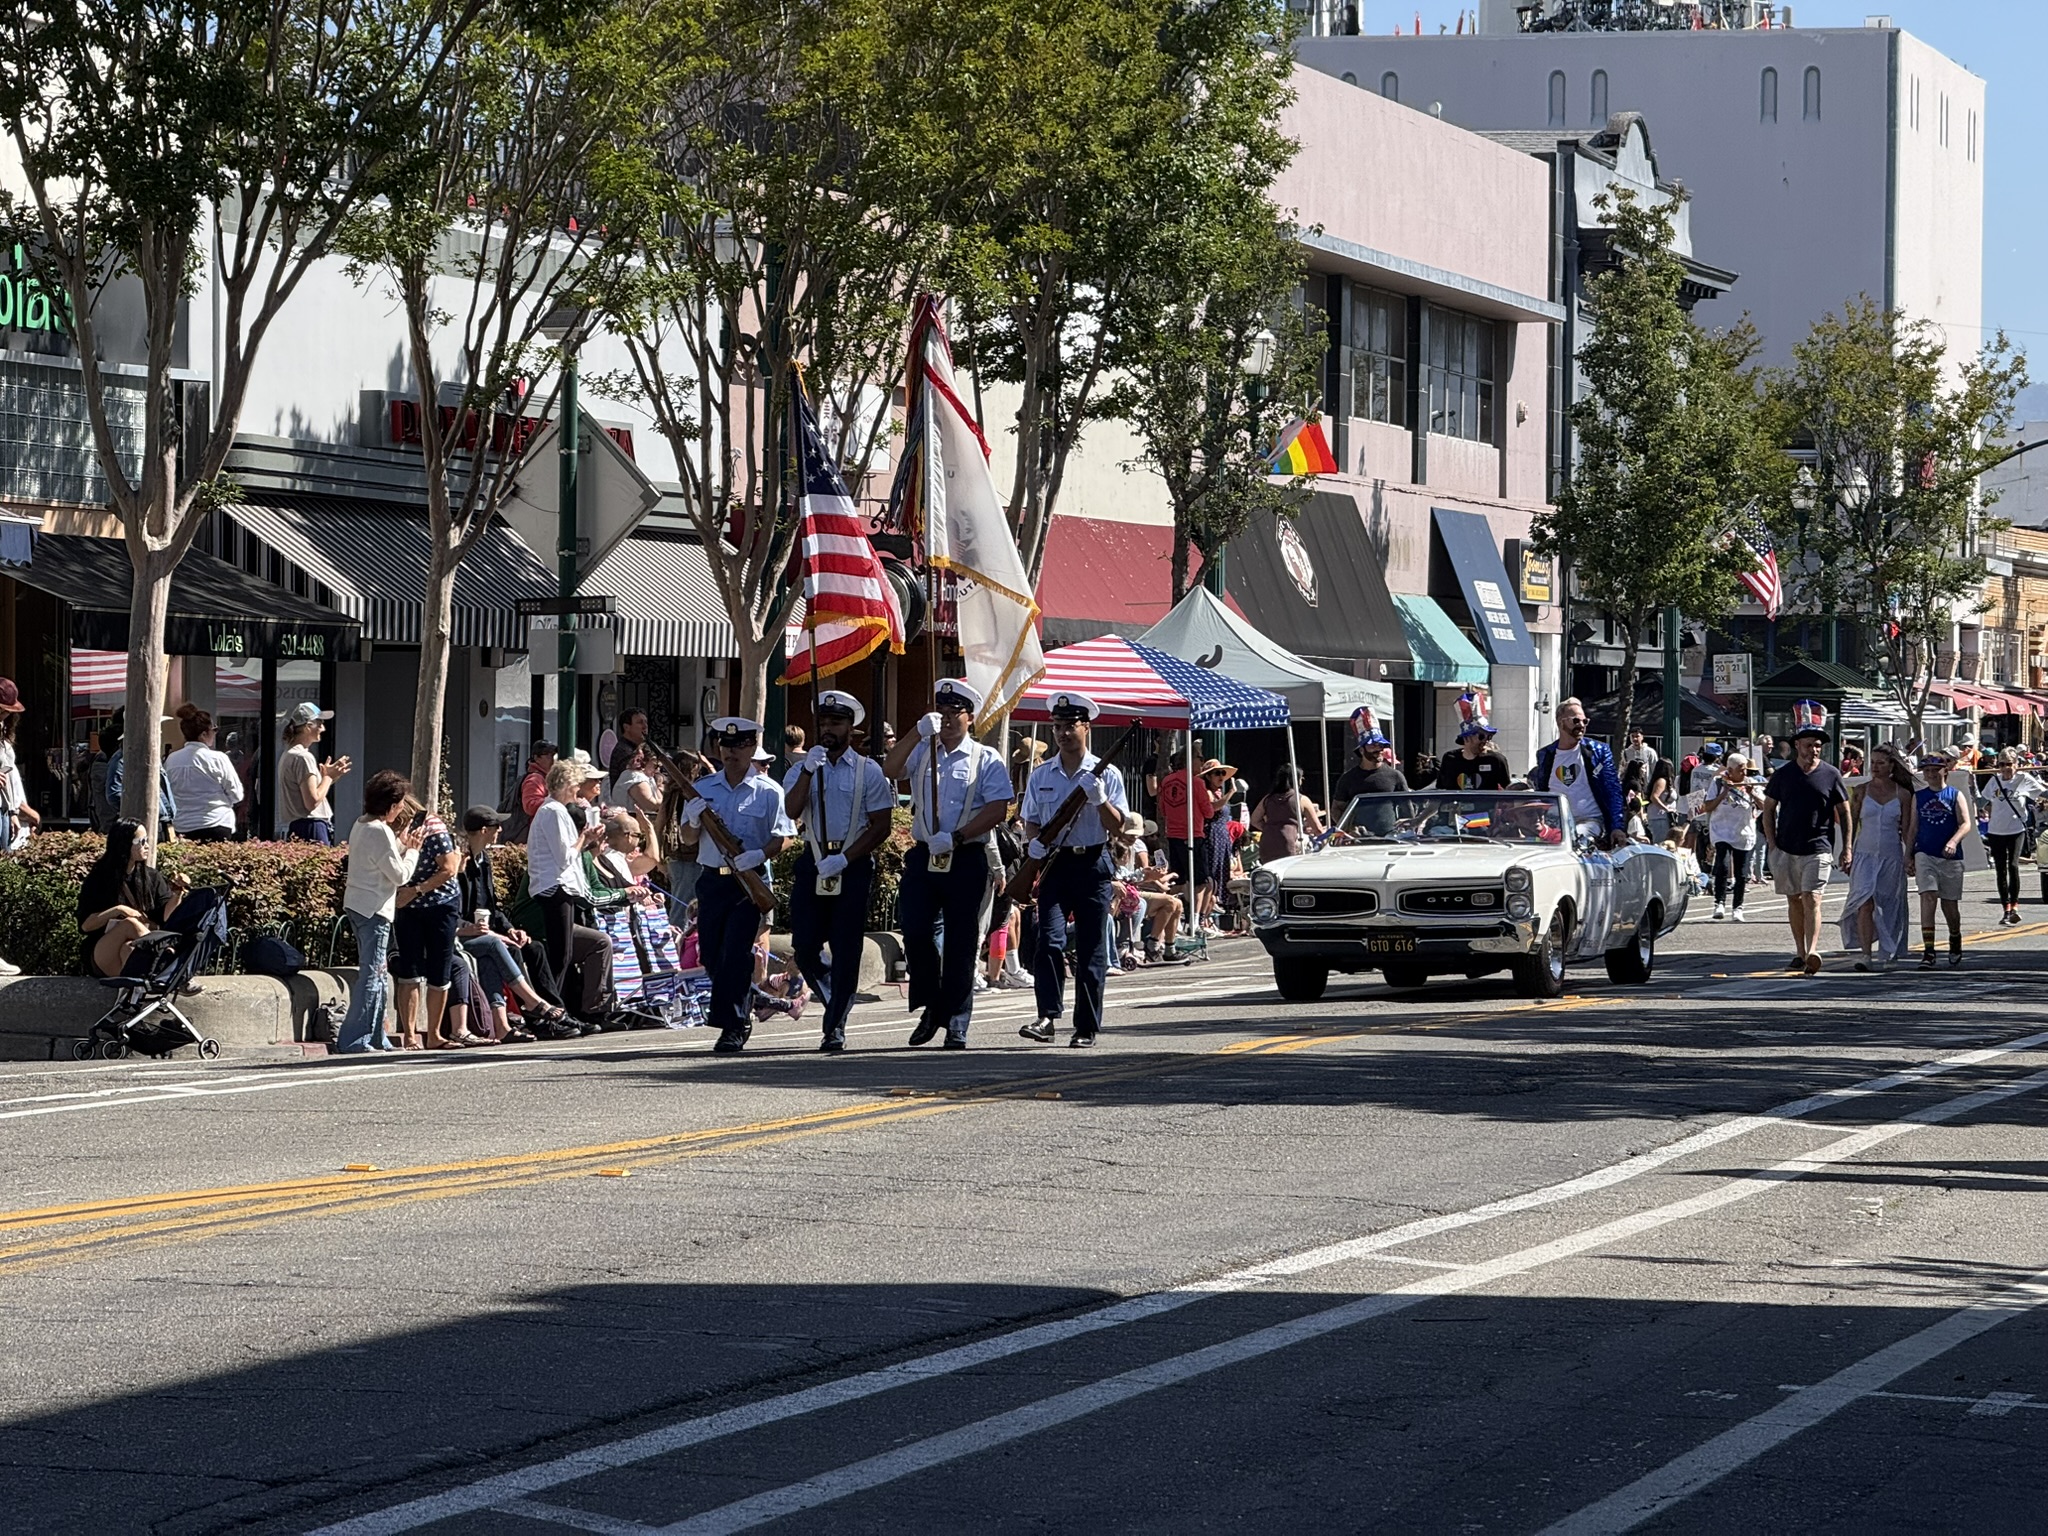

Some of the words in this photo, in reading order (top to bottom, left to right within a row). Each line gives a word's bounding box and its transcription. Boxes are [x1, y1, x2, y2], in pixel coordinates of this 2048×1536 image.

[208, 623, 243, 653] Lola's
[281, 633, 325, 656] 521-4488
[1715, 664, 1725, 672] 20
[1370, 940, 1389, 952] GTO
[1395, 940, 1414, 952] 6T6
